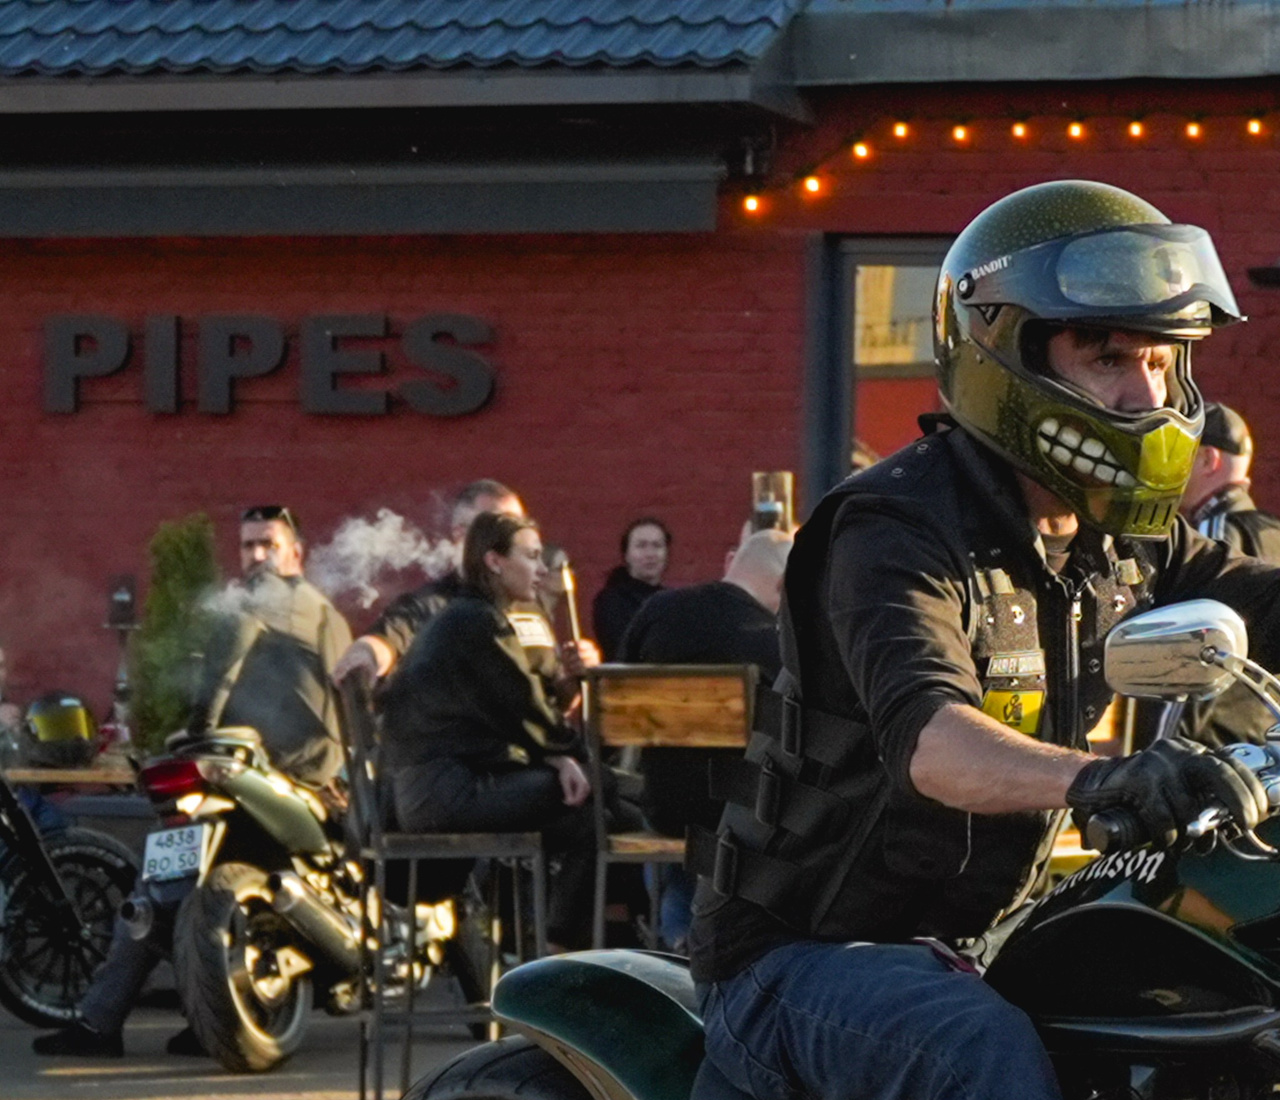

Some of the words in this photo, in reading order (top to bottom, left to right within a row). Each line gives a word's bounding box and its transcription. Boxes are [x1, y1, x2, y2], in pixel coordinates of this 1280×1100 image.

[970, 255, 1011, 280] BANDIT
[44, 313, 495, 416] PIPES
[155, 829, 195, 849] 4838
[178, 851, 198, 869] 50
